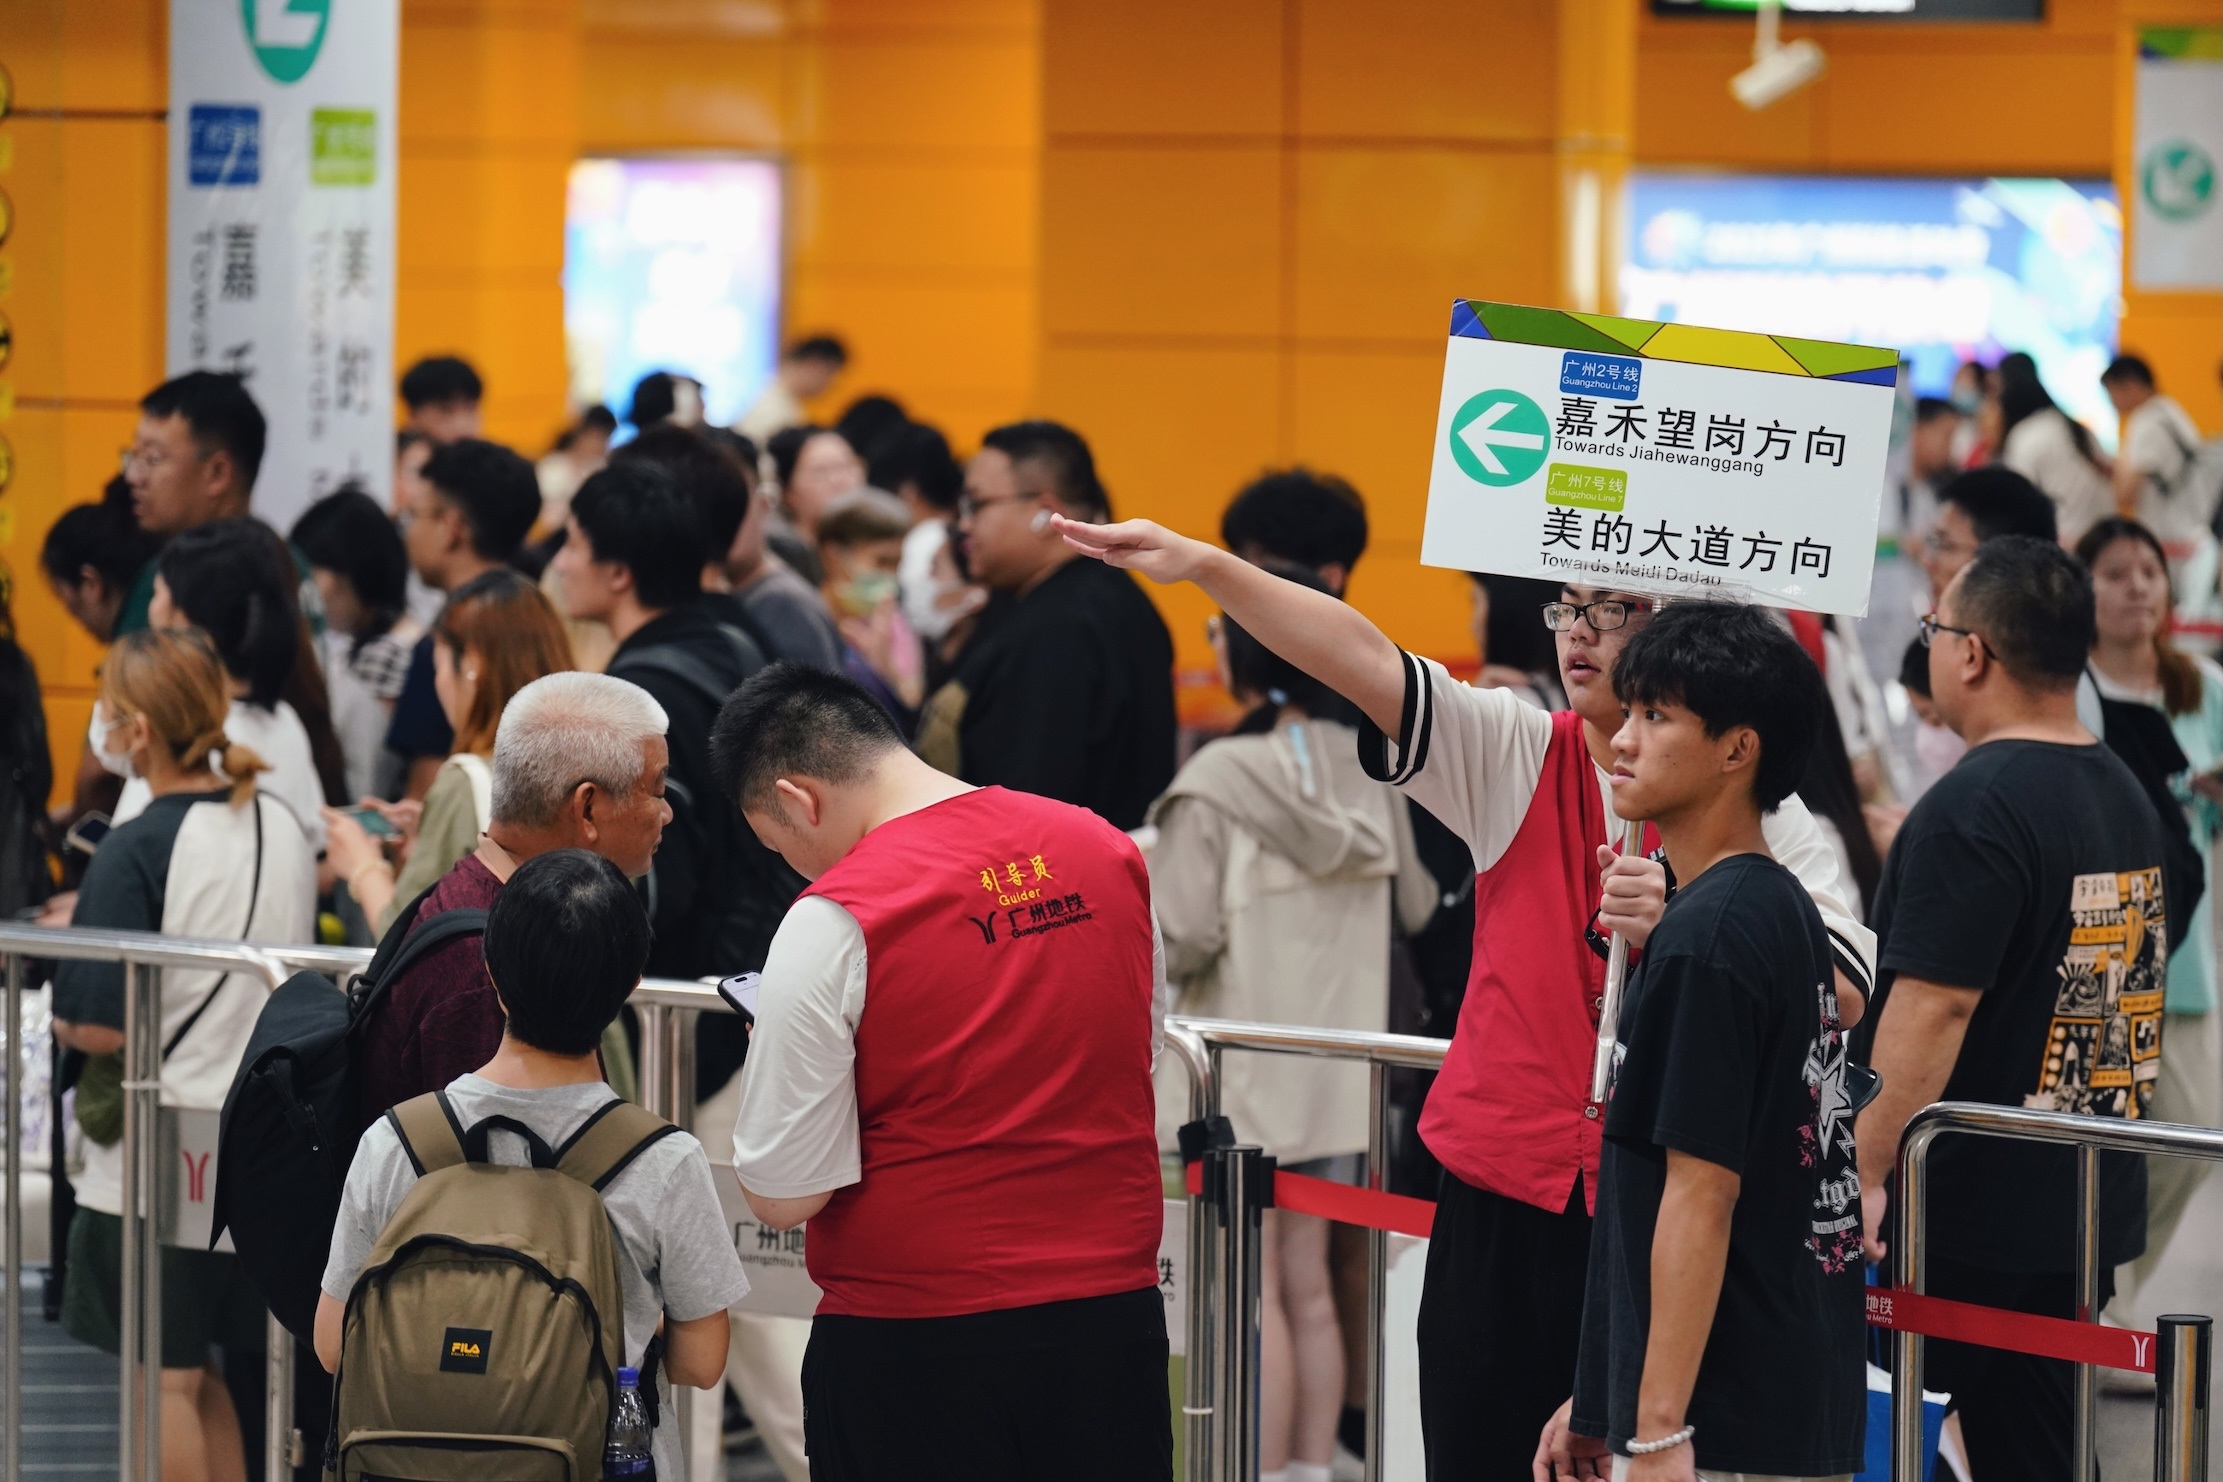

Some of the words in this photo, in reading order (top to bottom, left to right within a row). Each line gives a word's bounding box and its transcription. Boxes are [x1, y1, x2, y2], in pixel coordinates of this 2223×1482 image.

[1563, 359, 1639, 383] 广州2号线
[1562, 376, 1612, 390] Guangzhou
[1612, 382, 1631, 392] Line
[1631, 384, 1638, 393] 2
[1556, 397, 1846, 467] 嘉禾望岗方向
[1555, 436, 1625, 457] Towards
[1629, 446, 1764, 477] Jiahewanggang
[1548, 487, 1597, 501] Guangzhou
[1597, 493, 1616, 503] Line
[1617, 495, 1624, 503] 7
[1550, 471, 1625, 494] 广州7号线
[1542, 506, 1832, 578] 美的大道方向
[1540, 552, 1610, 573] Towards
[1615, 561, 1661, 580] Meidi
[1666, 567, 1721, 586] Dadao
[980, 855, 1053, 893] 引导员
[999, 888, 1041, 906] Guider
[1007, 893, 1086, 928] 广州地铁
[1011, 919, 1065, 938] Guangzhou
[1065, 912, 1092, 925] Metro
[739, 1253, 794, 1269] uangzhou
[451, 1342, 480, 1355] FILA
